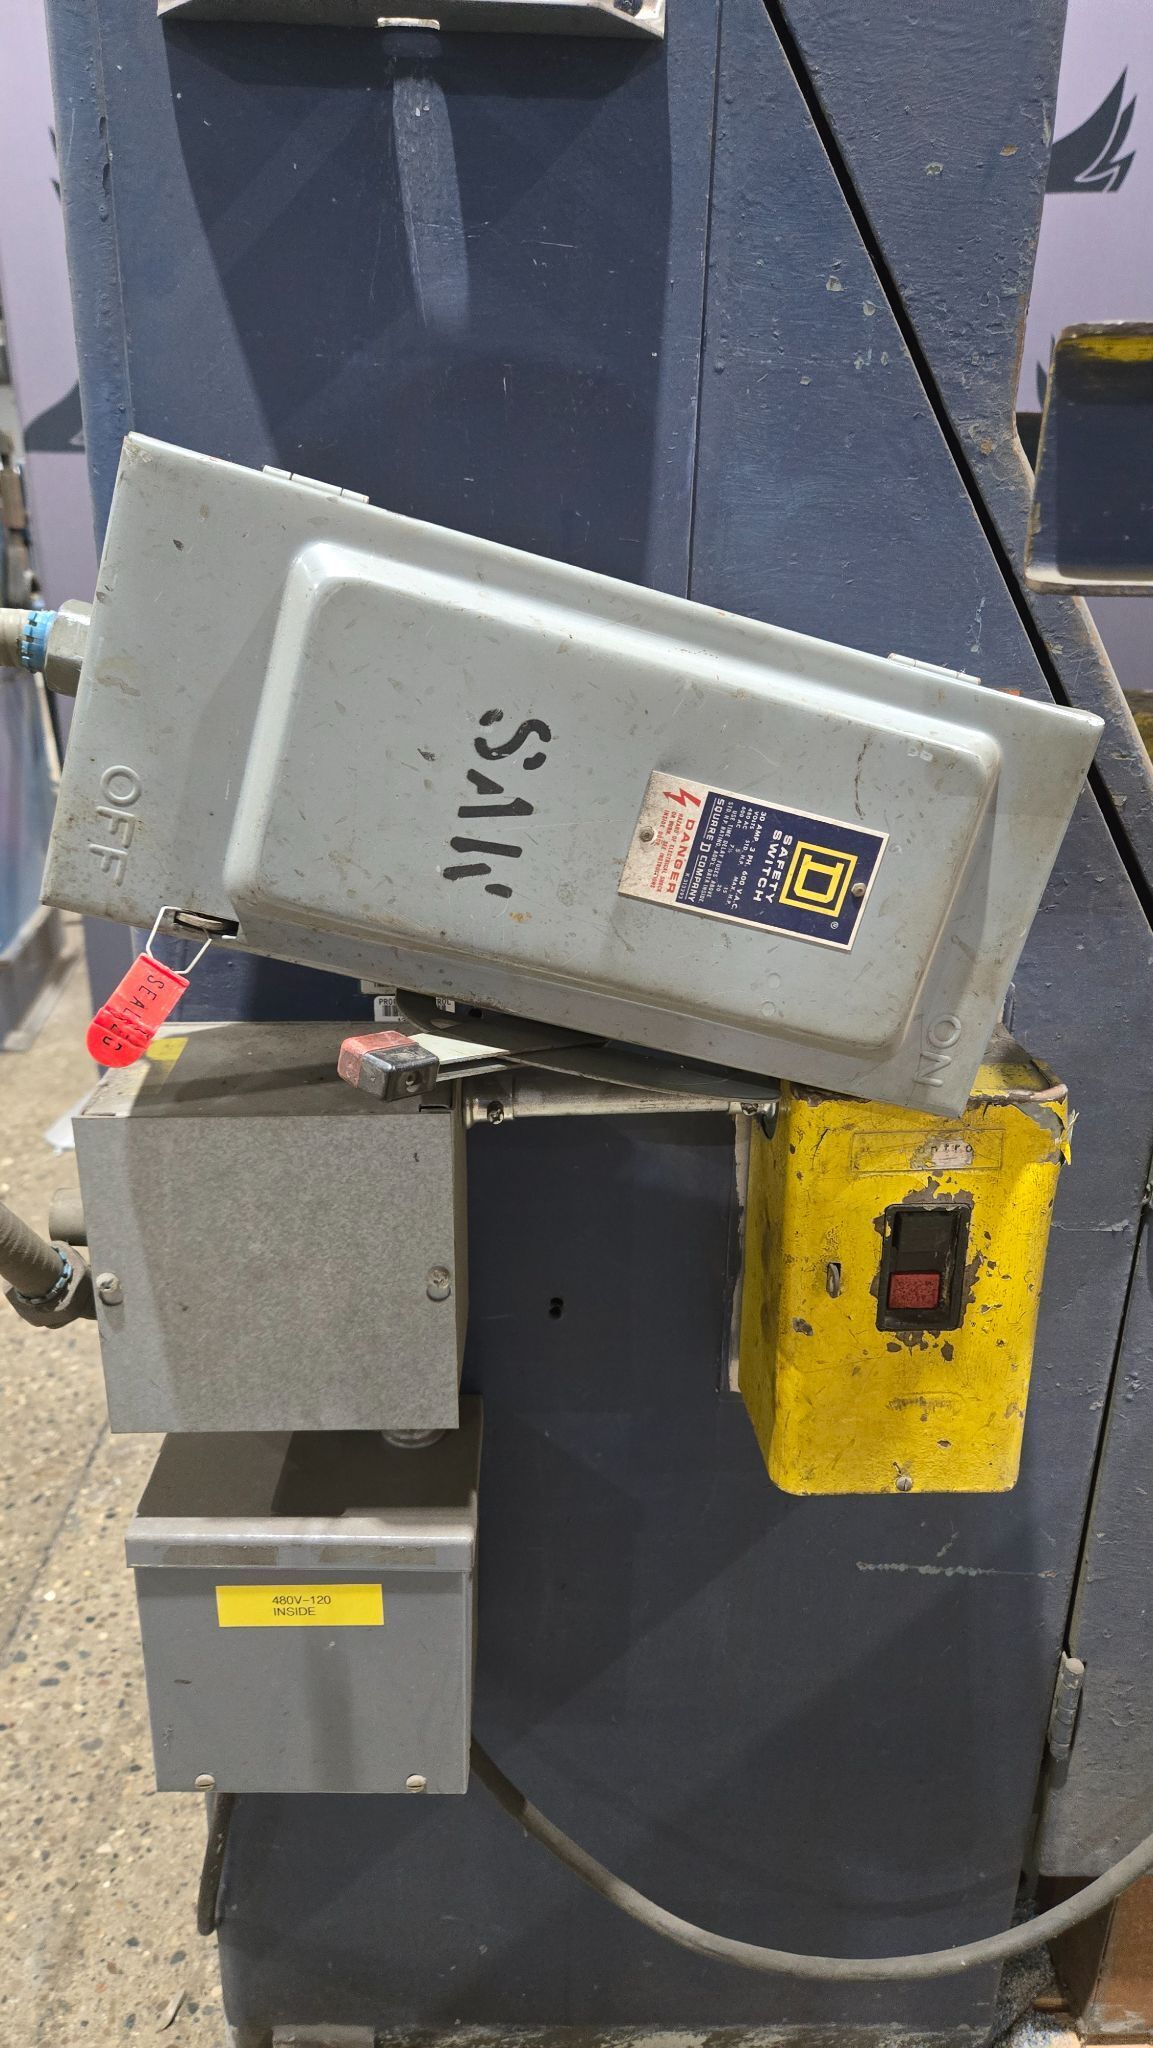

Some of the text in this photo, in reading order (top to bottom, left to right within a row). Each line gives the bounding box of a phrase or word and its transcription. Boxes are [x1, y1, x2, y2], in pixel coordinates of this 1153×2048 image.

[443, 708, 552, 899] SAW
[659, 809, 668, 827] INSIDE
[669, 811, 676, 819] OR
[673, 813, 683, 833] HAZARD
[735, 805, 746, 828] 600 AC
[742, 820, 748, 829] AC
[749, 810, 758, 829] VOLTS
[758, 811, 766, 821] 30
[89, 764, 142, 887] OFF
[751, 823, 762, 843] AMP.
[666, 818, 695, 893] DANGER
[687, 798, 724, 902] SQUARE D COMPANY
[706, 810, 737, 897] USE TIME DELAY FUSES ABOVE
[741, 839, 749, 853] STD.
[661, 844, 674, 873] ELECTRICAL
[744, 854, 752, 867] PH.
[752, 829, 782, 901] SWITCH
[649, 852, 664, 888] INSTRUCIONS
[704, 868, 712, 882] DATA
[738, 870, 747, 885] 600
[763, 834, 792, 904] SAFETY
[791, 853, 844, 904] D
[656, 876, 665, 892] SHOCK
[729, 875, 738, 892] MAX.
[730, 888, 742, 910] V.A.C.
[912, 1012, 961, 1088] ON
[272, 1595, 332, 1605] 480V-120
[273, 1606, 316, 1616] INSIDE
